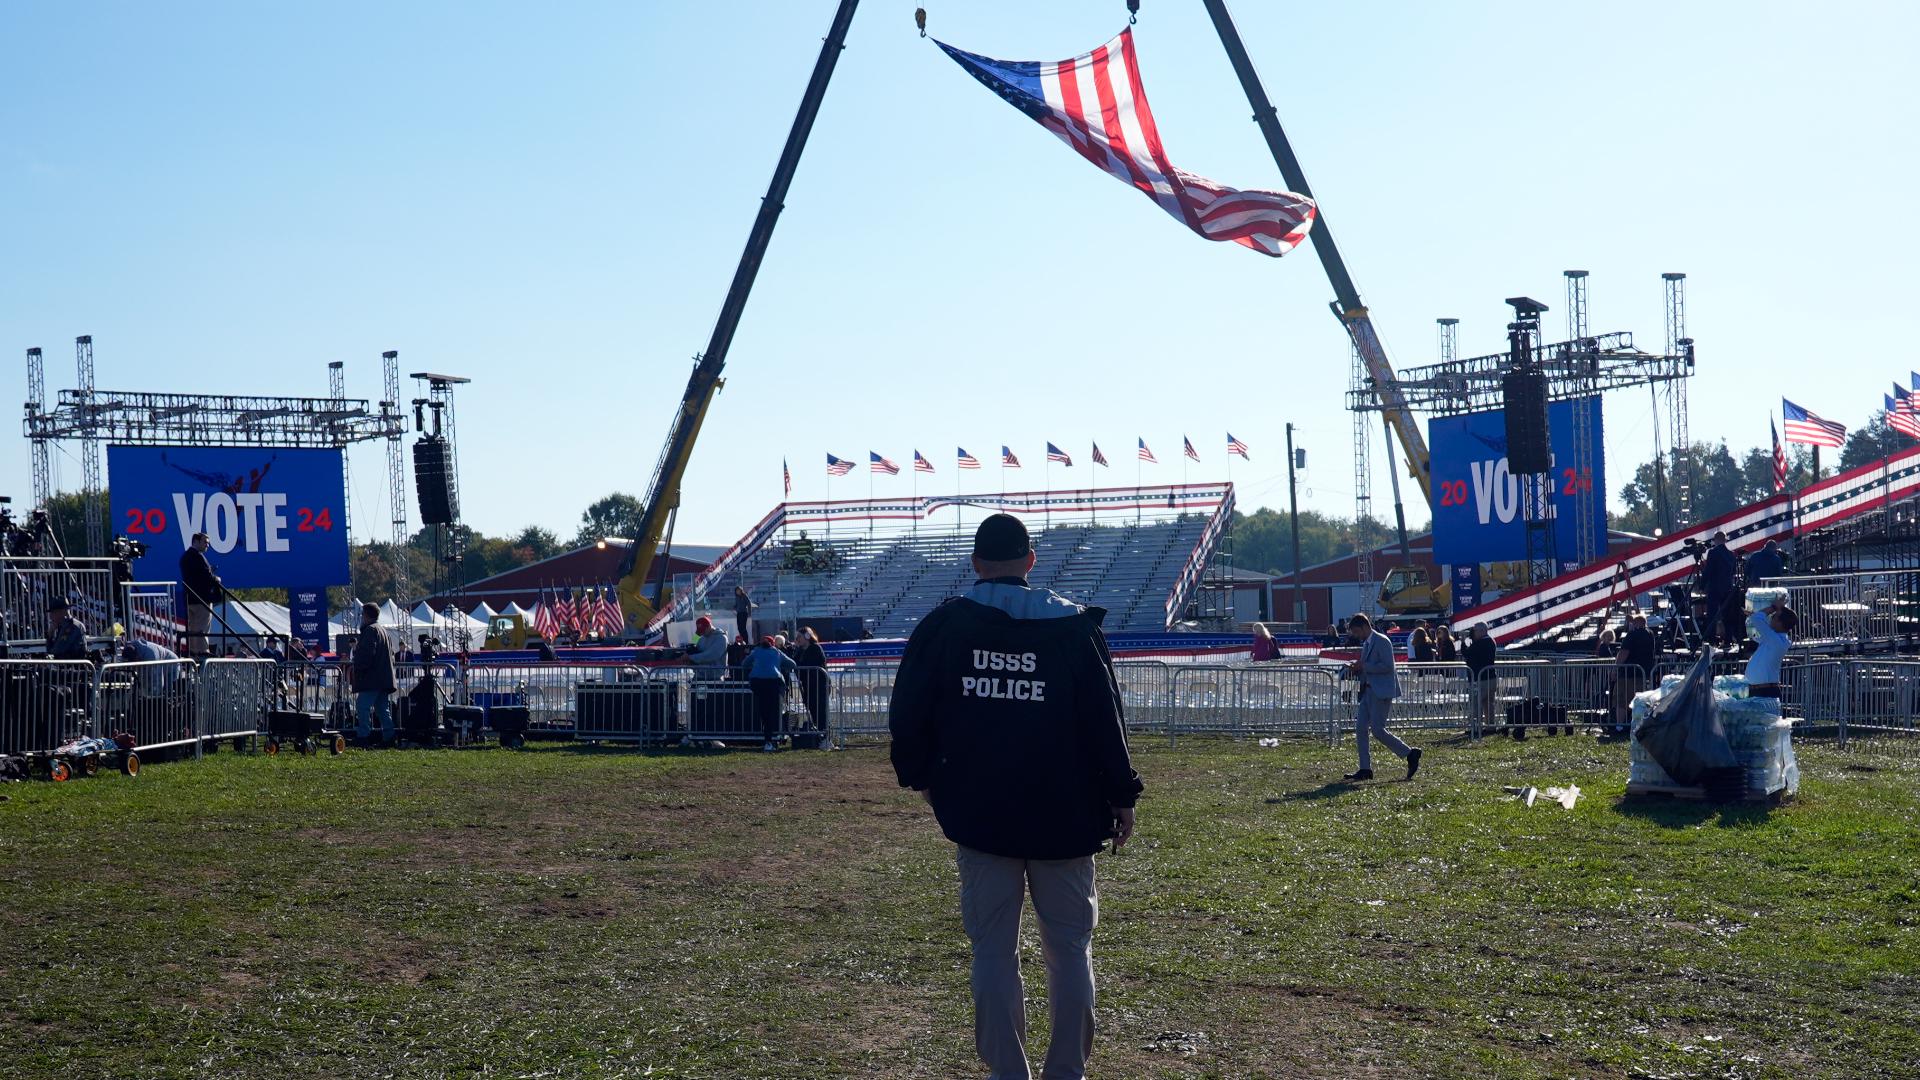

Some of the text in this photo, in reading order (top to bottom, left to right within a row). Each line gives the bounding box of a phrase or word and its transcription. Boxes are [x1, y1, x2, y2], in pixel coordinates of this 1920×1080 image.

[1440, 479, 1467, 506] 20
[126, 491, 333, 554] 20 VOTE 24
[973, 649, 1037, 672] USSS
[962, 677, 1046, 702] POLICE
